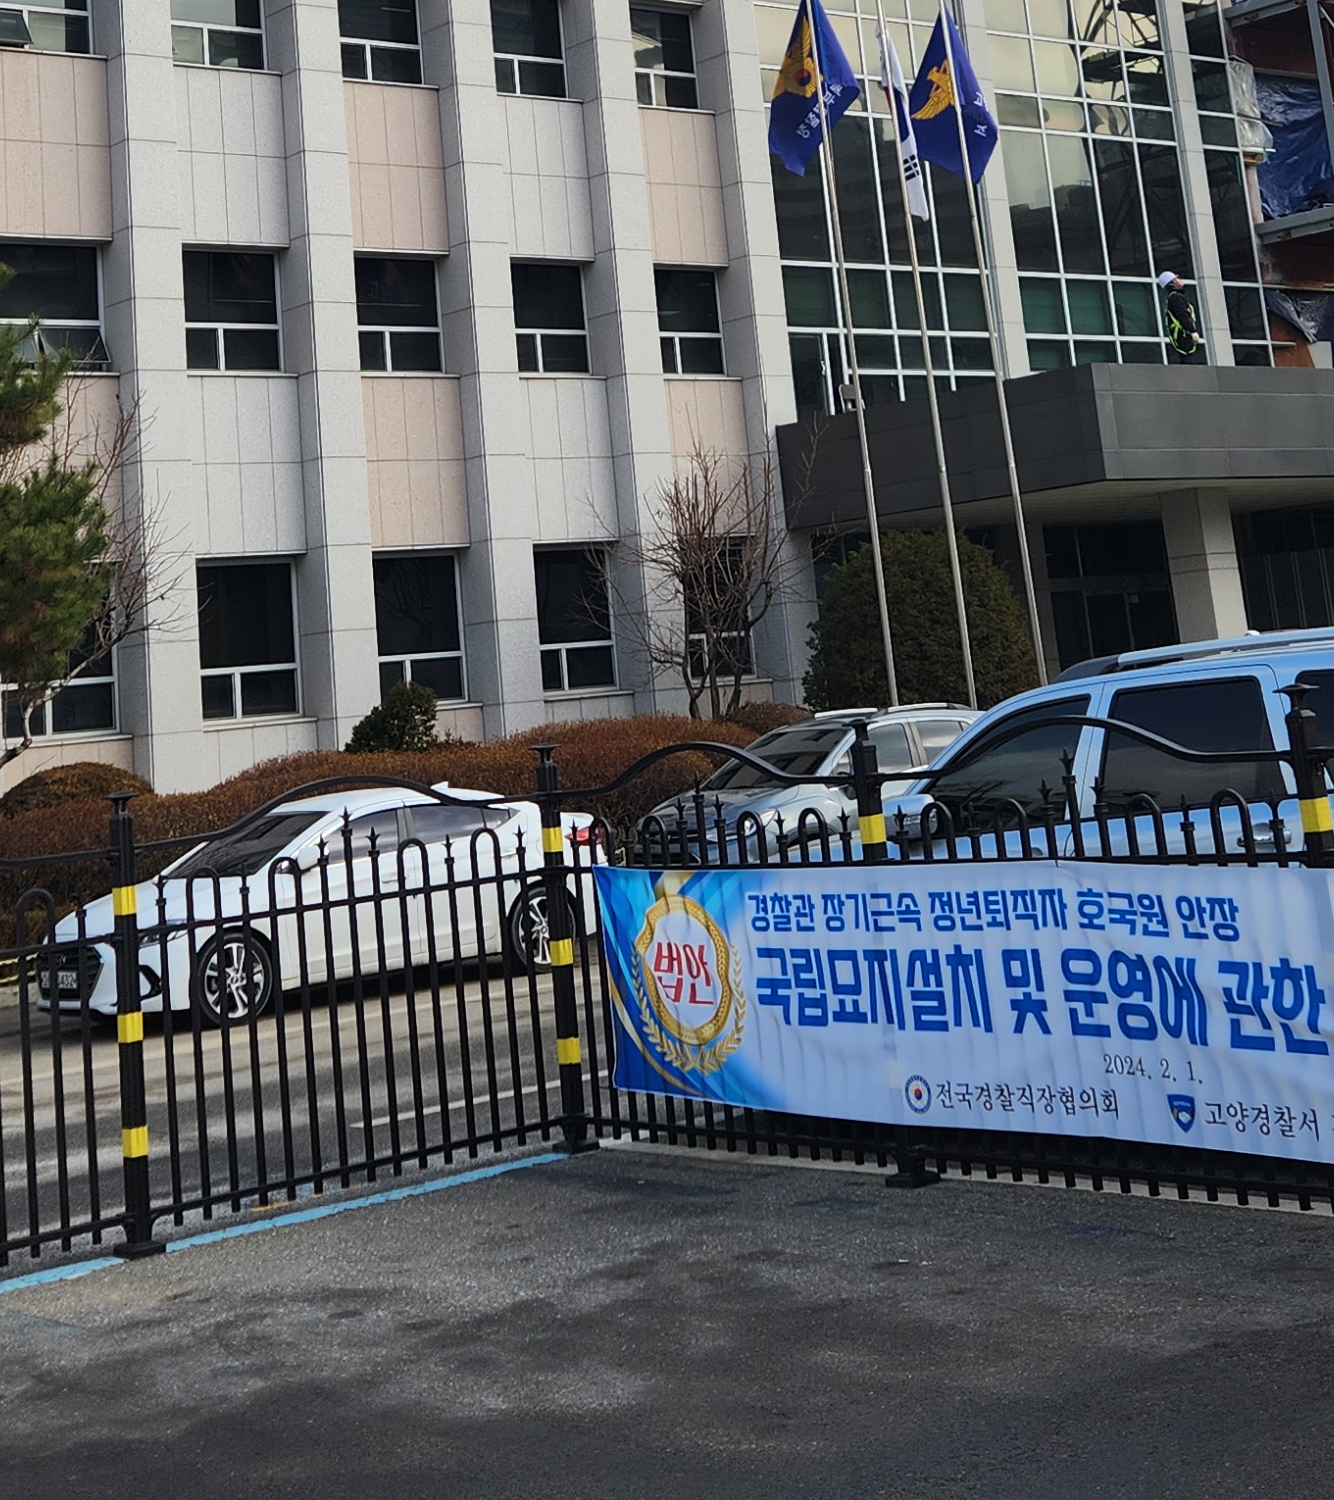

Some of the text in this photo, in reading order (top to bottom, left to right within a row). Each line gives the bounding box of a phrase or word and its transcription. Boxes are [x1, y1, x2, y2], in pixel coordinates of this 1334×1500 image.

[747, 888, 1240, 942] 경찰관 장기근속 정년퇴직자 호국원 안장
[654, 942, 714, 1005] 법안
[756, 944, 993, 1033] 국립묘지설치
[1001, 948, 1052, 1035] 및
[1061, 948, 1209, 1046] 운영에
[1218, 957, 1329, 1056] 관한
[1103, 1054, 1203, 1085] 2024. 2. 1.
[936, 1080, 1119, 1120] 전국경찰직장협의회
[1204, 1101, 1320, 1142] 고양경찰서
